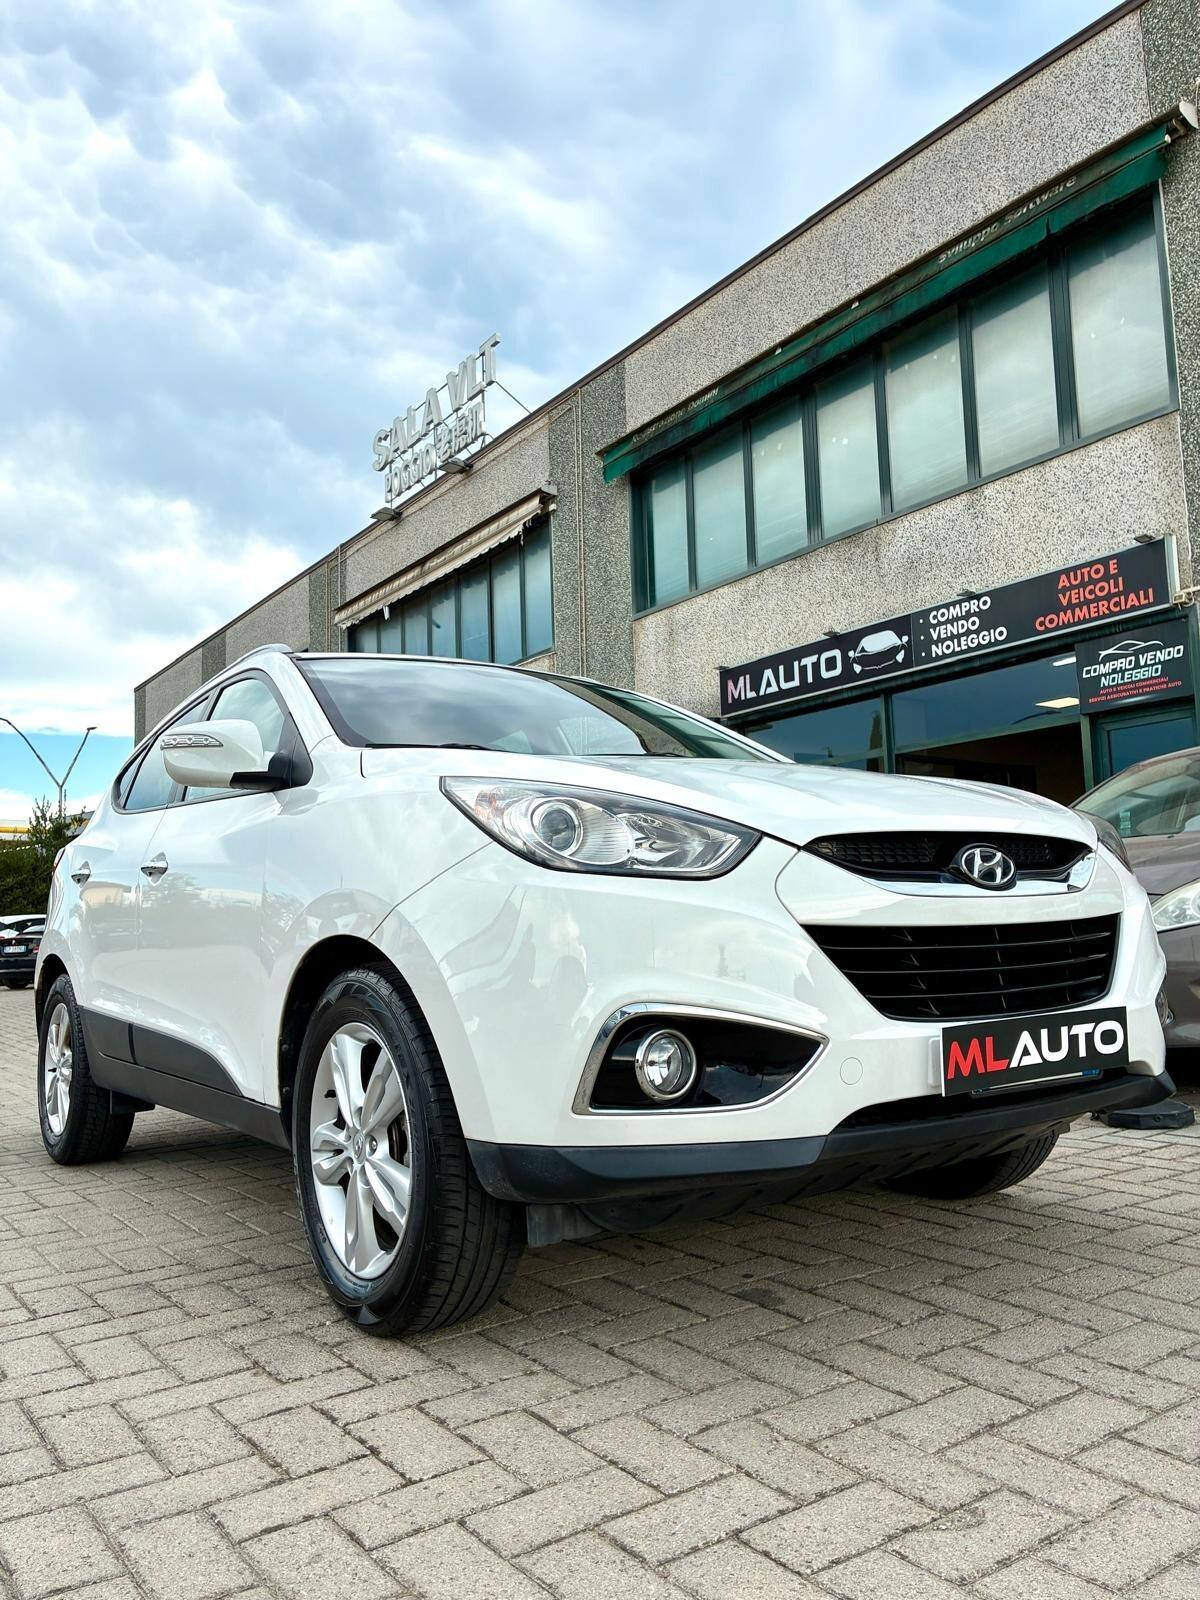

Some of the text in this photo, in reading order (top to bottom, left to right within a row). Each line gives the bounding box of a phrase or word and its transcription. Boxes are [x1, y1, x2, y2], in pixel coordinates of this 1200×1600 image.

[373, 332, 502, 472] SALA VLT
[1058, 559, 1118, 590] AUTO E
[1058, 576, 1124, 607] VEICOLI
[929, 595, 992, 625] COMPRO
[1035, 587, 1154, 632] COMMERCIALI
[930, 616, 980, 641] VENDO
[931, 626, 1008, 658] NOLEGGIO
[1082, 645, 1184, 678] COMPRO VENDO
[1100, 664, 1162, 688] NOLEGGIO
[1100, 687, 1112, 695] AUTO
[1167, 680, 1182, 688] AUTO
